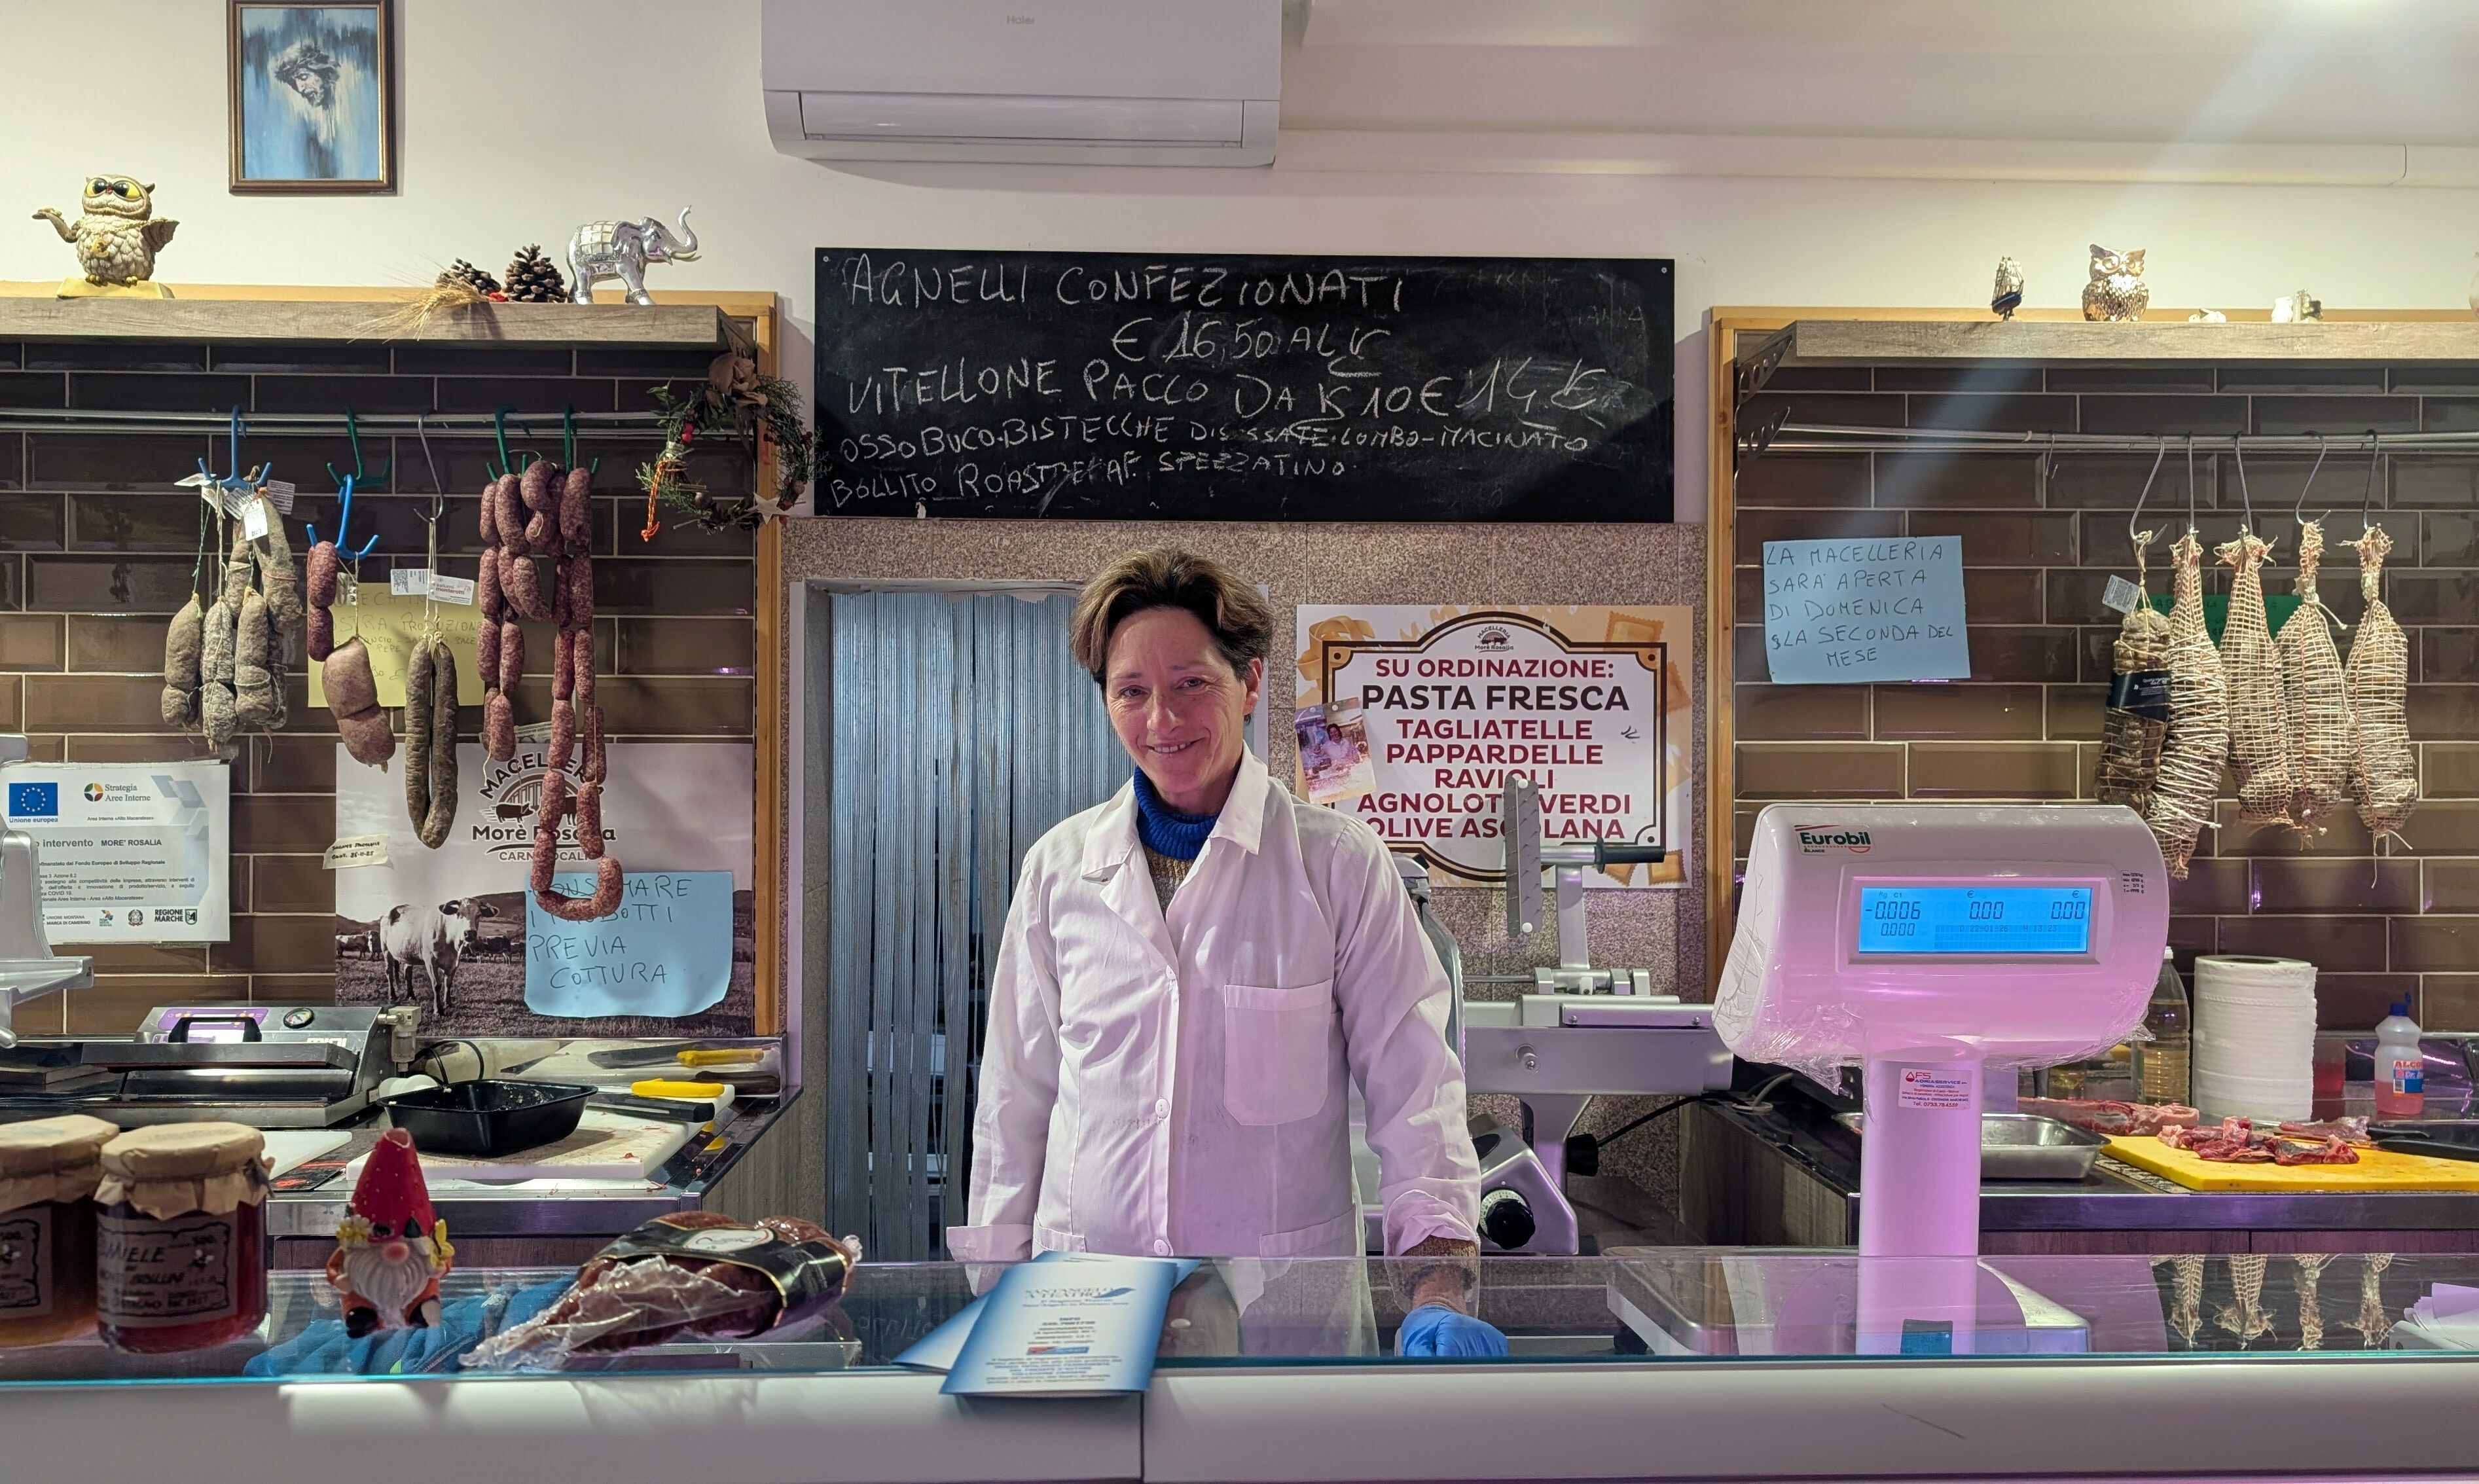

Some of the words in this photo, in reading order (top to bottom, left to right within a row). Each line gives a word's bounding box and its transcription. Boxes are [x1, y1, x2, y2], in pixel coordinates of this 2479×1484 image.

[1006, 15, 1035, 24] Haier
[1057, 264, 1403, 312] CONFEZIONATI
[849, 356, 1062, 415] VITELLONE
[1083, 358, 1209, 406] PACCO
[830, 473, 937, 509] BOLLITO
[1765, 545, 1795, 566] LA
[1810, 541, 1944, 567] MACELLERIA
[1837, 568, 1927, 590] APERTA
[1769, 603, 1790, 621] DI
[1804, 597, 1924, 622] DOMENICA
[1477, 625, 1511, 639] MACELLERIA
[1818, 624, 1921, 644] SECONDA
[1928, 624, 1954, 639] DEL
[1826, 647, 1878, 667] MESE
[1375, 659, 1410, 678] SU
[1417, 659, 1615, 679] ORDINAZIONE:
[1362, 684, 1476, 711] PASTA
[1486, 684, 1630, 712] FRESCA
[1396, 719, 1593, 740] TAGLIATELLE
[1386, 744, 1603, 765] PAPPARDELLE
[104, 783, 138, 792] Strategia
[104, 794, 124, 803] Aree
[124, 793, 151, 802] Interne
[1356, 793, 1504, 814] AGNOLOT
[1538, 793, 1631, 814] VERDI
[471, 823, 528, 841] Morè
[1367, 818, 1453, 839] OLIVE
[1460, 818, 1625, 839] ASLANA
[1800, 831, 1872, 845] Eurobil
[43, 839, 94, 848] intervento
[528, 933, 627, 962] PREVIA
[550, 962, 667, 989] COTTURA
